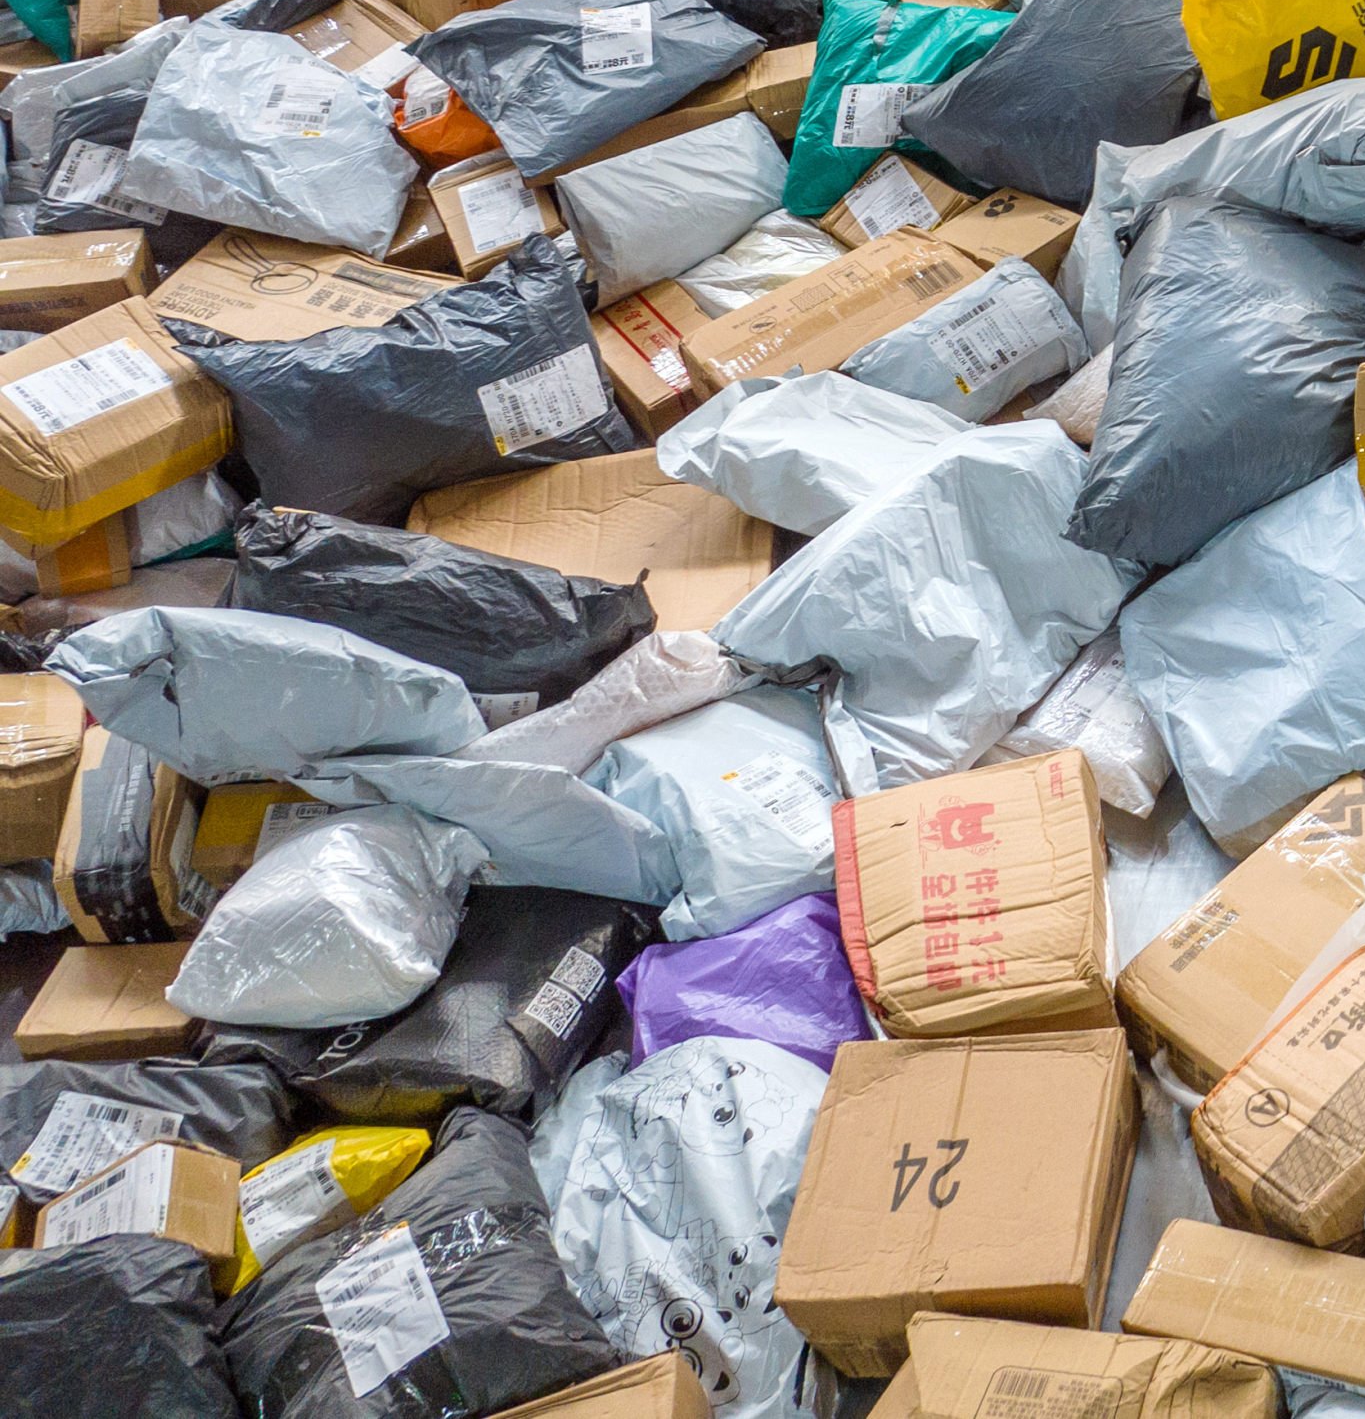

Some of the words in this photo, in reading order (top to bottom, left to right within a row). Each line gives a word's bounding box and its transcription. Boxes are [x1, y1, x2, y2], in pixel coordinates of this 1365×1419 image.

[921, 873, 962, 992] 全场包邮
[1255, 1093, 1282, 1121] A
[889, 1137, 970, 1213] 24
